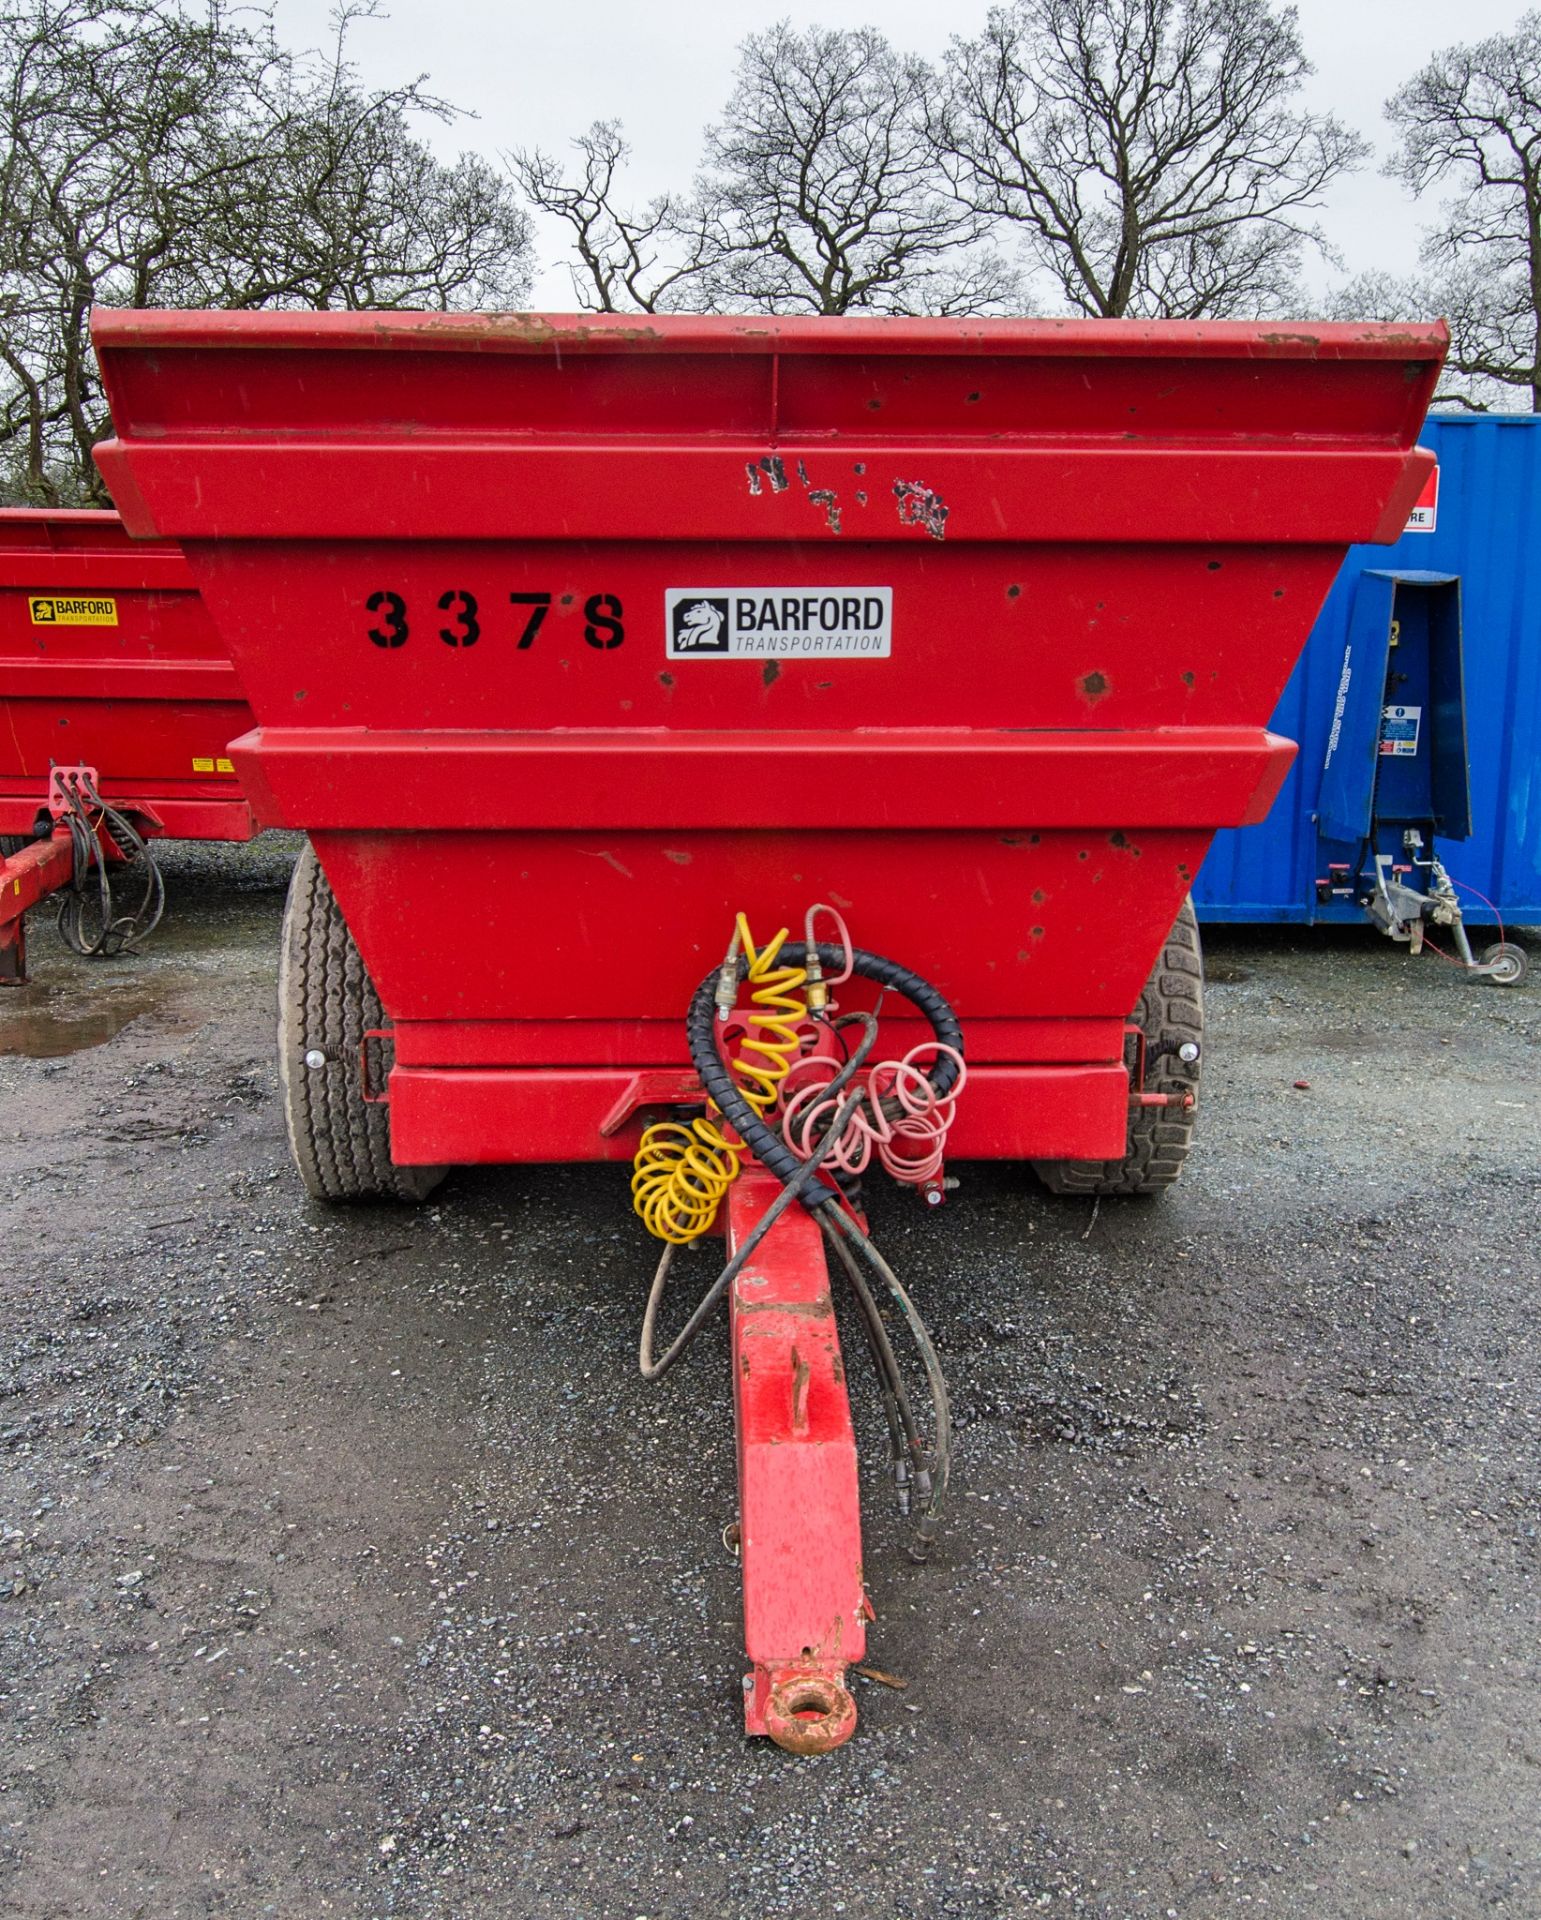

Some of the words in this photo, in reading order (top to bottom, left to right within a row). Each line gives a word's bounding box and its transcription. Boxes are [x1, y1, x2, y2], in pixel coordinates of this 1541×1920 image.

[56, 600, 113, 615] BARFORD
[736, 598, 884, 631] BARFORD
[735, 635, 883, 651] TRANSPORTATION
